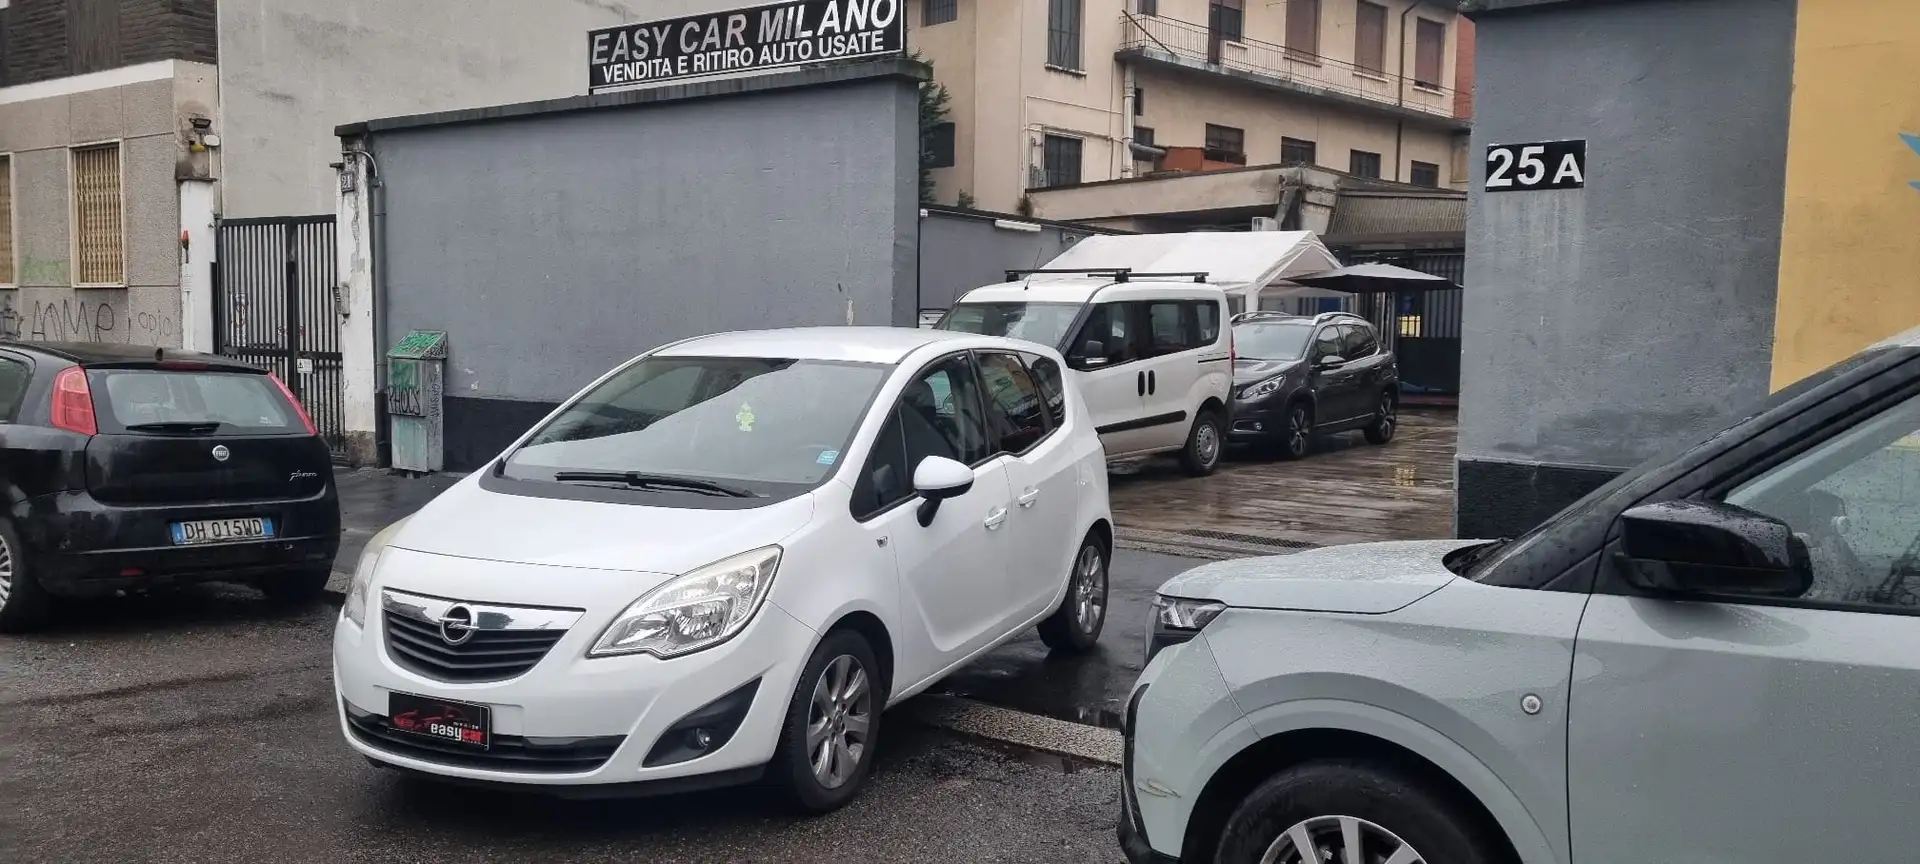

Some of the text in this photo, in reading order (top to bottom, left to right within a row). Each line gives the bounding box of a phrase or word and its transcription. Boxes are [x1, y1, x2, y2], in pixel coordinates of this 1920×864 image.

[592, 0, 897, 65] EASY CAR MILANO
[603, 30, 884, 84] VENDITA E RITIRO AUTO USATE
[1485, 145, 1584, 187] 25 A
[184, 521, 206, 540] DH
